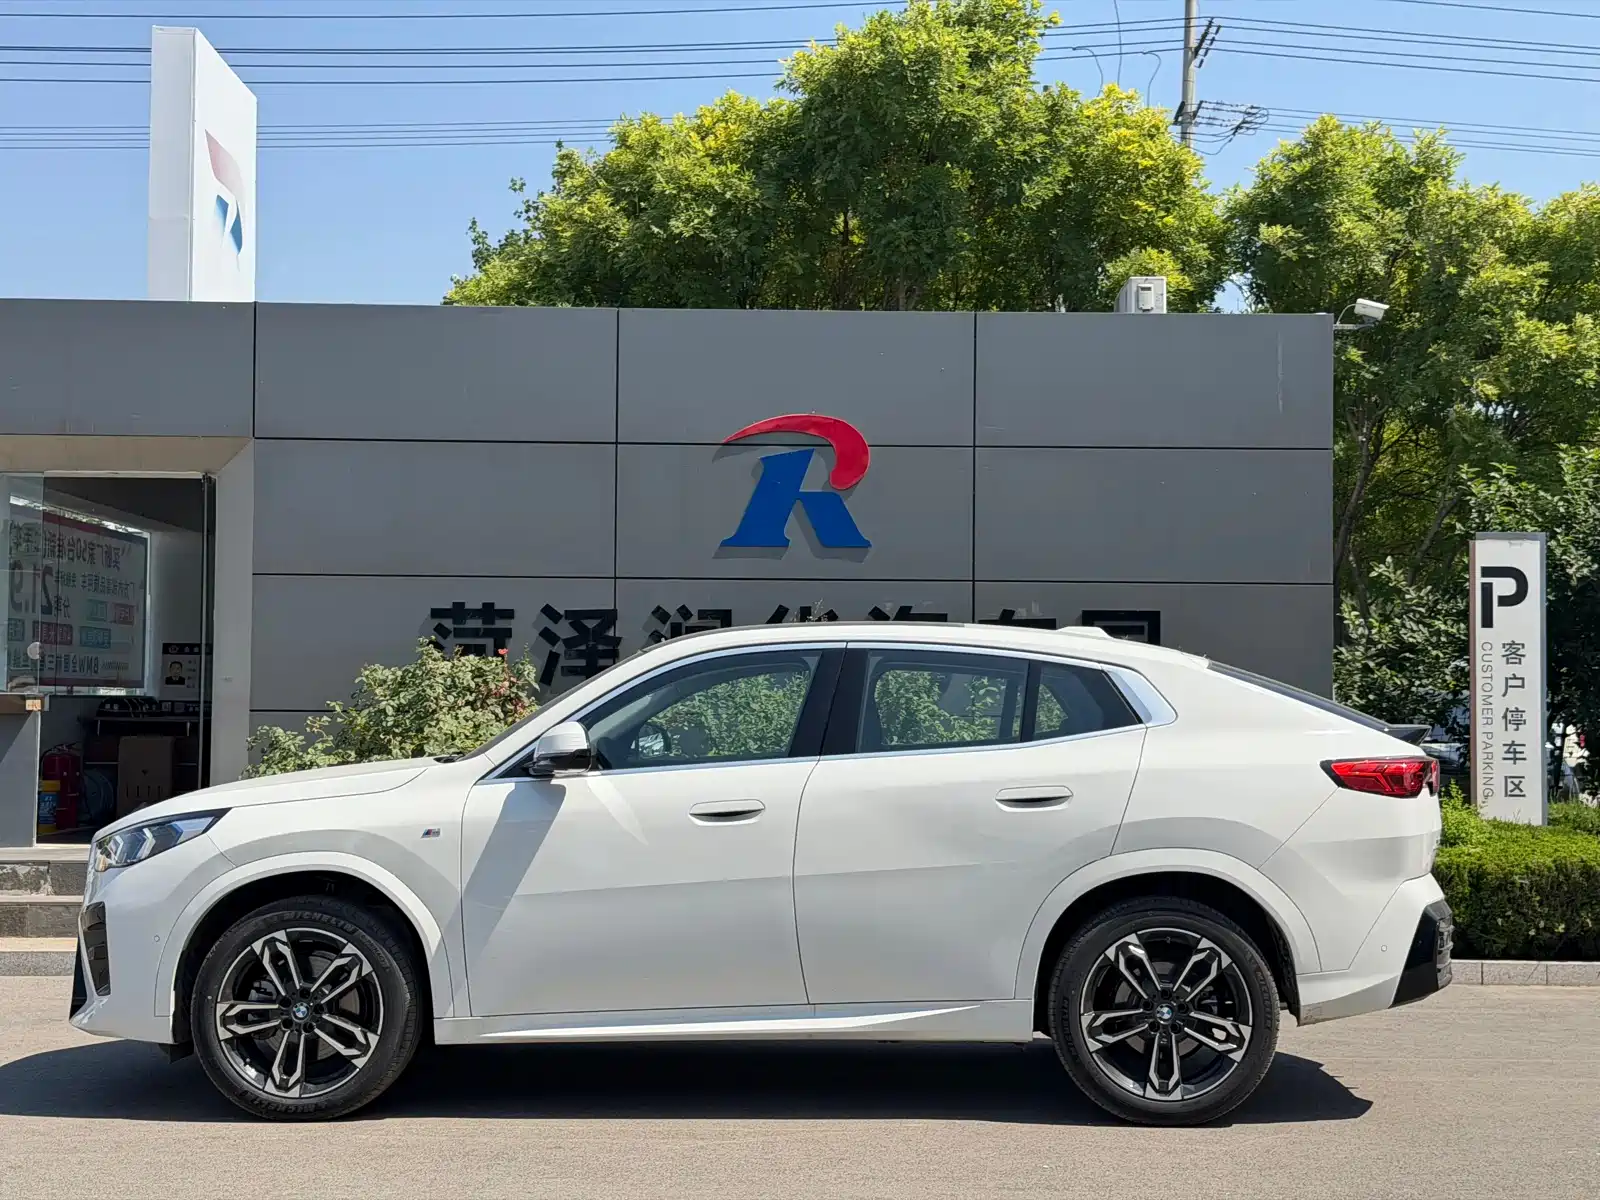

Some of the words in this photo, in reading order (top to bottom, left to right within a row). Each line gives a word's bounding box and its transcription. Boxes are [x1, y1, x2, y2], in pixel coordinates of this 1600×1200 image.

[719, 414, 872, 548] R
[1480, 565, 1529, 628] P
[1480, 641, 1494, 726] CUSTOMER
[1501, 640, 1527, 798] 客户停车区
[1482, 731, 1495, 798] PARKING
[284, 911, 354, 932] MICHELIN
